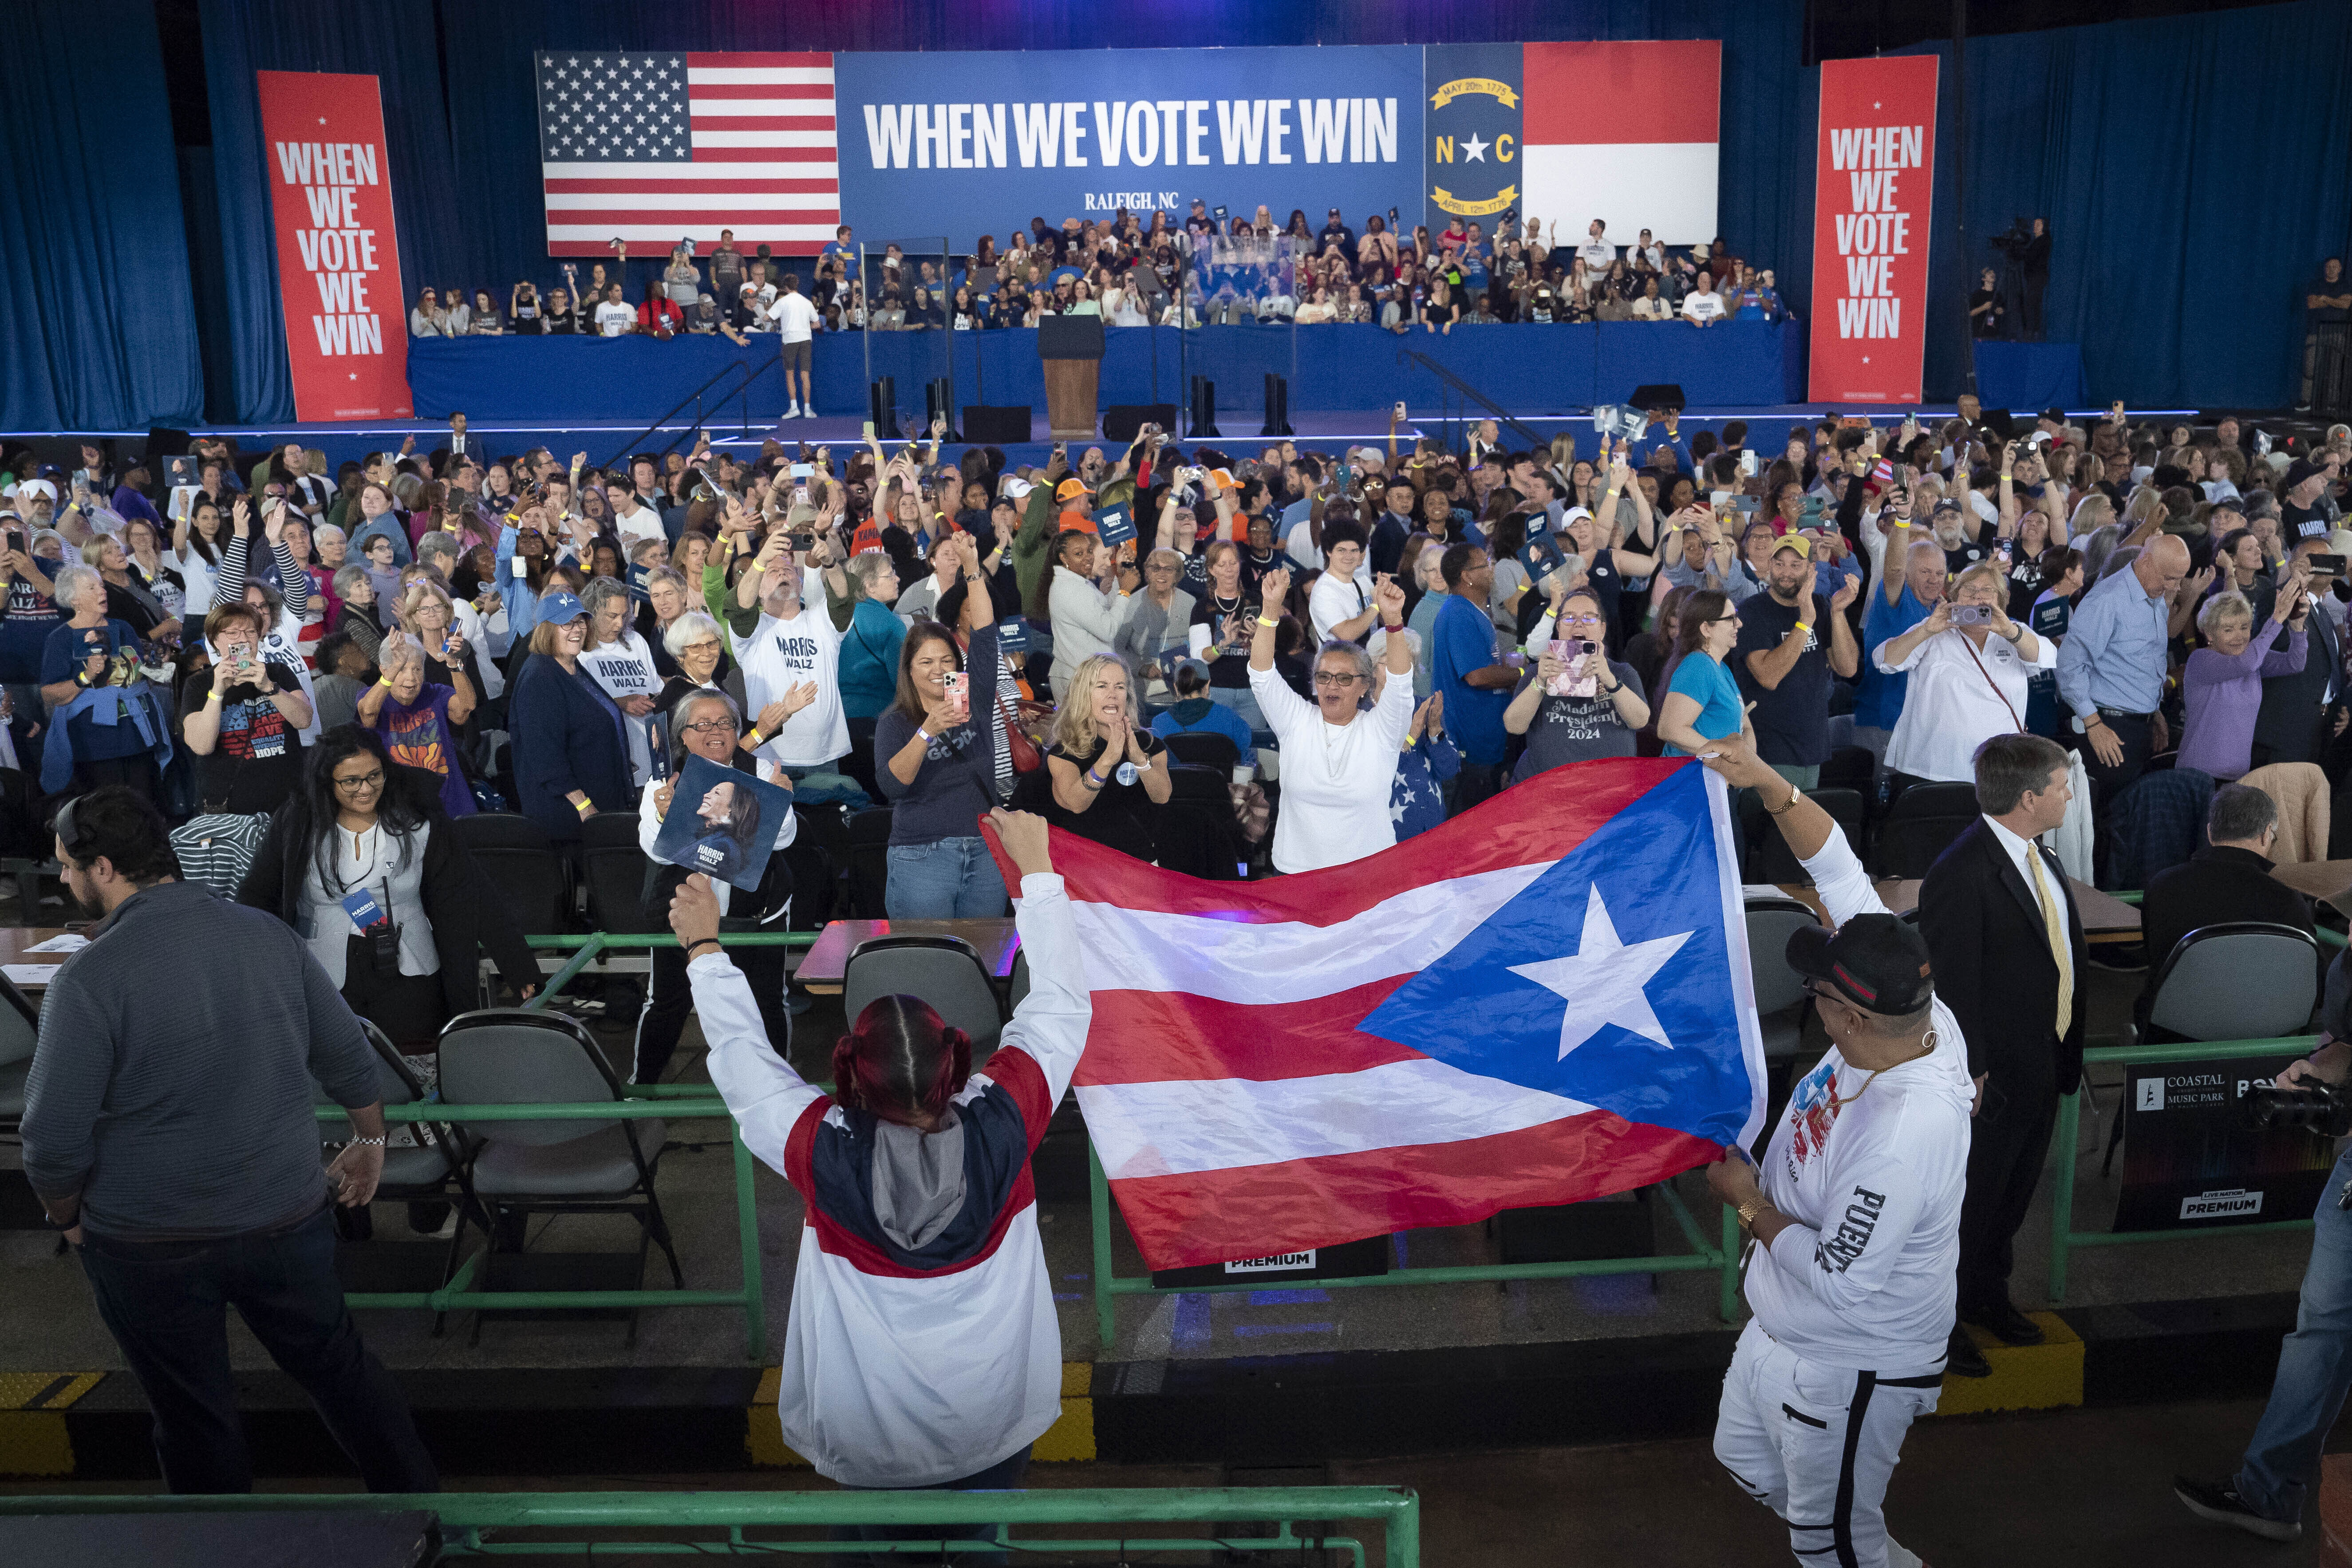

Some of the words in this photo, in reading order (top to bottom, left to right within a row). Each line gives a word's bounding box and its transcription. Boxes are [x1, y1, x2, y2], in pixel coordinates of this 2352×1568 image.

[1443, 83, 1461, 95] MAY
[1487, 83, 1506, 96] 1775
[864, 103, 1007, 169] WHEN
[1012, 103, 1089, 167] WE
[1093, 100, 1210, 167] VOTE
[1216, 99, 1292, 165] WE
[1298, 98, 1398, 164] WIN
[1436, 136, 1453, 163] N
[1496, 134, 1514, 162] C
[1830, 126, 1923, 171] WHEN
[276, 142, 379, 185] WHEN
[1850, 171, 1899, 213] WE
[305, 186, 360, 228] WE
[1085, 193, 1156, 210] RALEIGH,
[1159, 192, 1179, 209] NC
[1441, 198, 1466, 214] APRIL
[1488, 199, 1507, 210] 1776
[1835, 213, 1909, 255] VOTE
[296, 229, 379, 271] VOTE
[1846, 256, 1895, 297] WE
[316, 273, 371, 313] WE
[1837, 298, 1901, 339] WIN
[313, 314, 383, 356] WIN
[1103, 512, 1121, 525] HARRIS
[152, 586, 178, 598] WALZ
[11, 596, 36, 609] ALZ
[2042, 606, 2060, 619] HARRIS
[999, 624, 1019, 633] HARRIS
[776, 636, 817, 657] HARRIS
[597, 659, 648, 677] HARRIS
[785, 657, 814, 669] WALZ
[612, 678, 647, 688] WALZ
[1552, 699, 1610, 715] Madam
[1546, 710, 1621, 730] President
[1567, 728, 1600, 739] 2024
[255, 745, 286, 758] HOPE
[697, 844, 724, 861] HARRIS
[699, 854, 718, 865] WALZ
[351, 901, 375, 917] HARRIS
[2168, 1074, 2225, 1087] COASTAL
[2168, 1094, 2198, 1103] MUSIC
[2201, 1093, 2224, 1101] PARK
[2186, 1200, 2257, 1215] PREMIUM
[1231, 1253, 1310, 1268] PREMIUM
